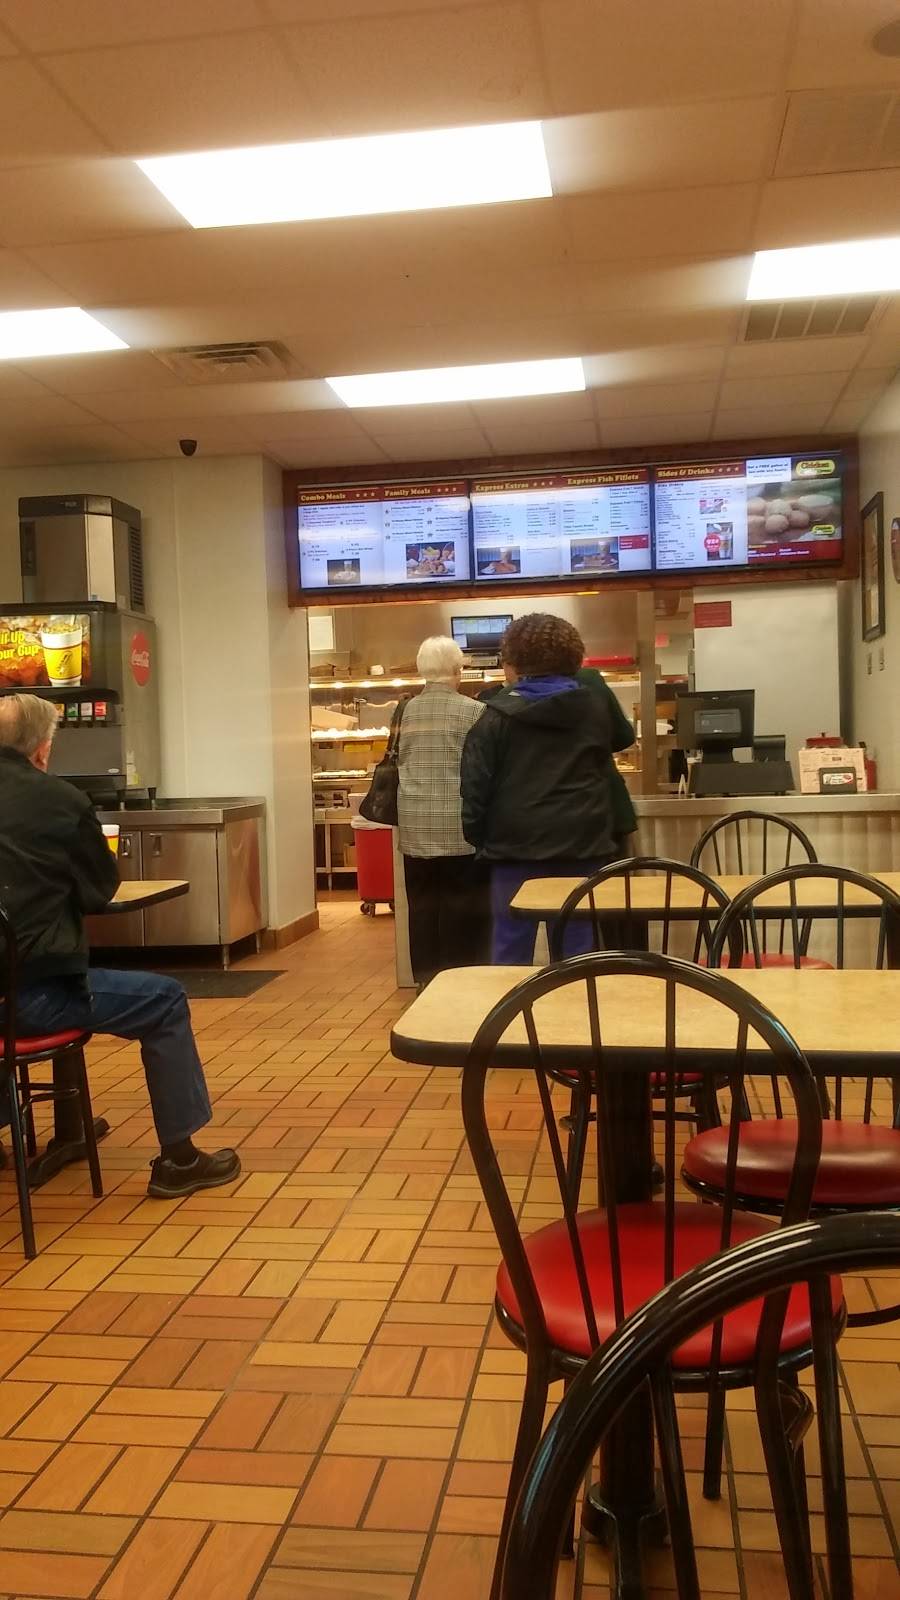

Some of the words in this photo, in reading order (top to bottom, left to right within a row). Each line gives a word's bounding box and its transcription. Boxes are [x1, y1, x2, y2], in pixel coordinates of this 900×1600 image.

[800, 461, 830, 469] Chicken
[657, 469, 678, 478] Sides
[679, 468, 687, 476] &
[687, 467, 715, 475] Drinks
[567, 476, 597, 485] Express
[598, 475, 614, 483] Fish
[614, 473, 639, 481] Fillets
[475, 484, 504, 492] Express
[505, 482, 529, 490] Extras
[300, 494, 325, 502] Combo
[384, 489, 410, 497] Family
[10, 631, 25, 645] Up
[17, 645, 39, 657] Cup
